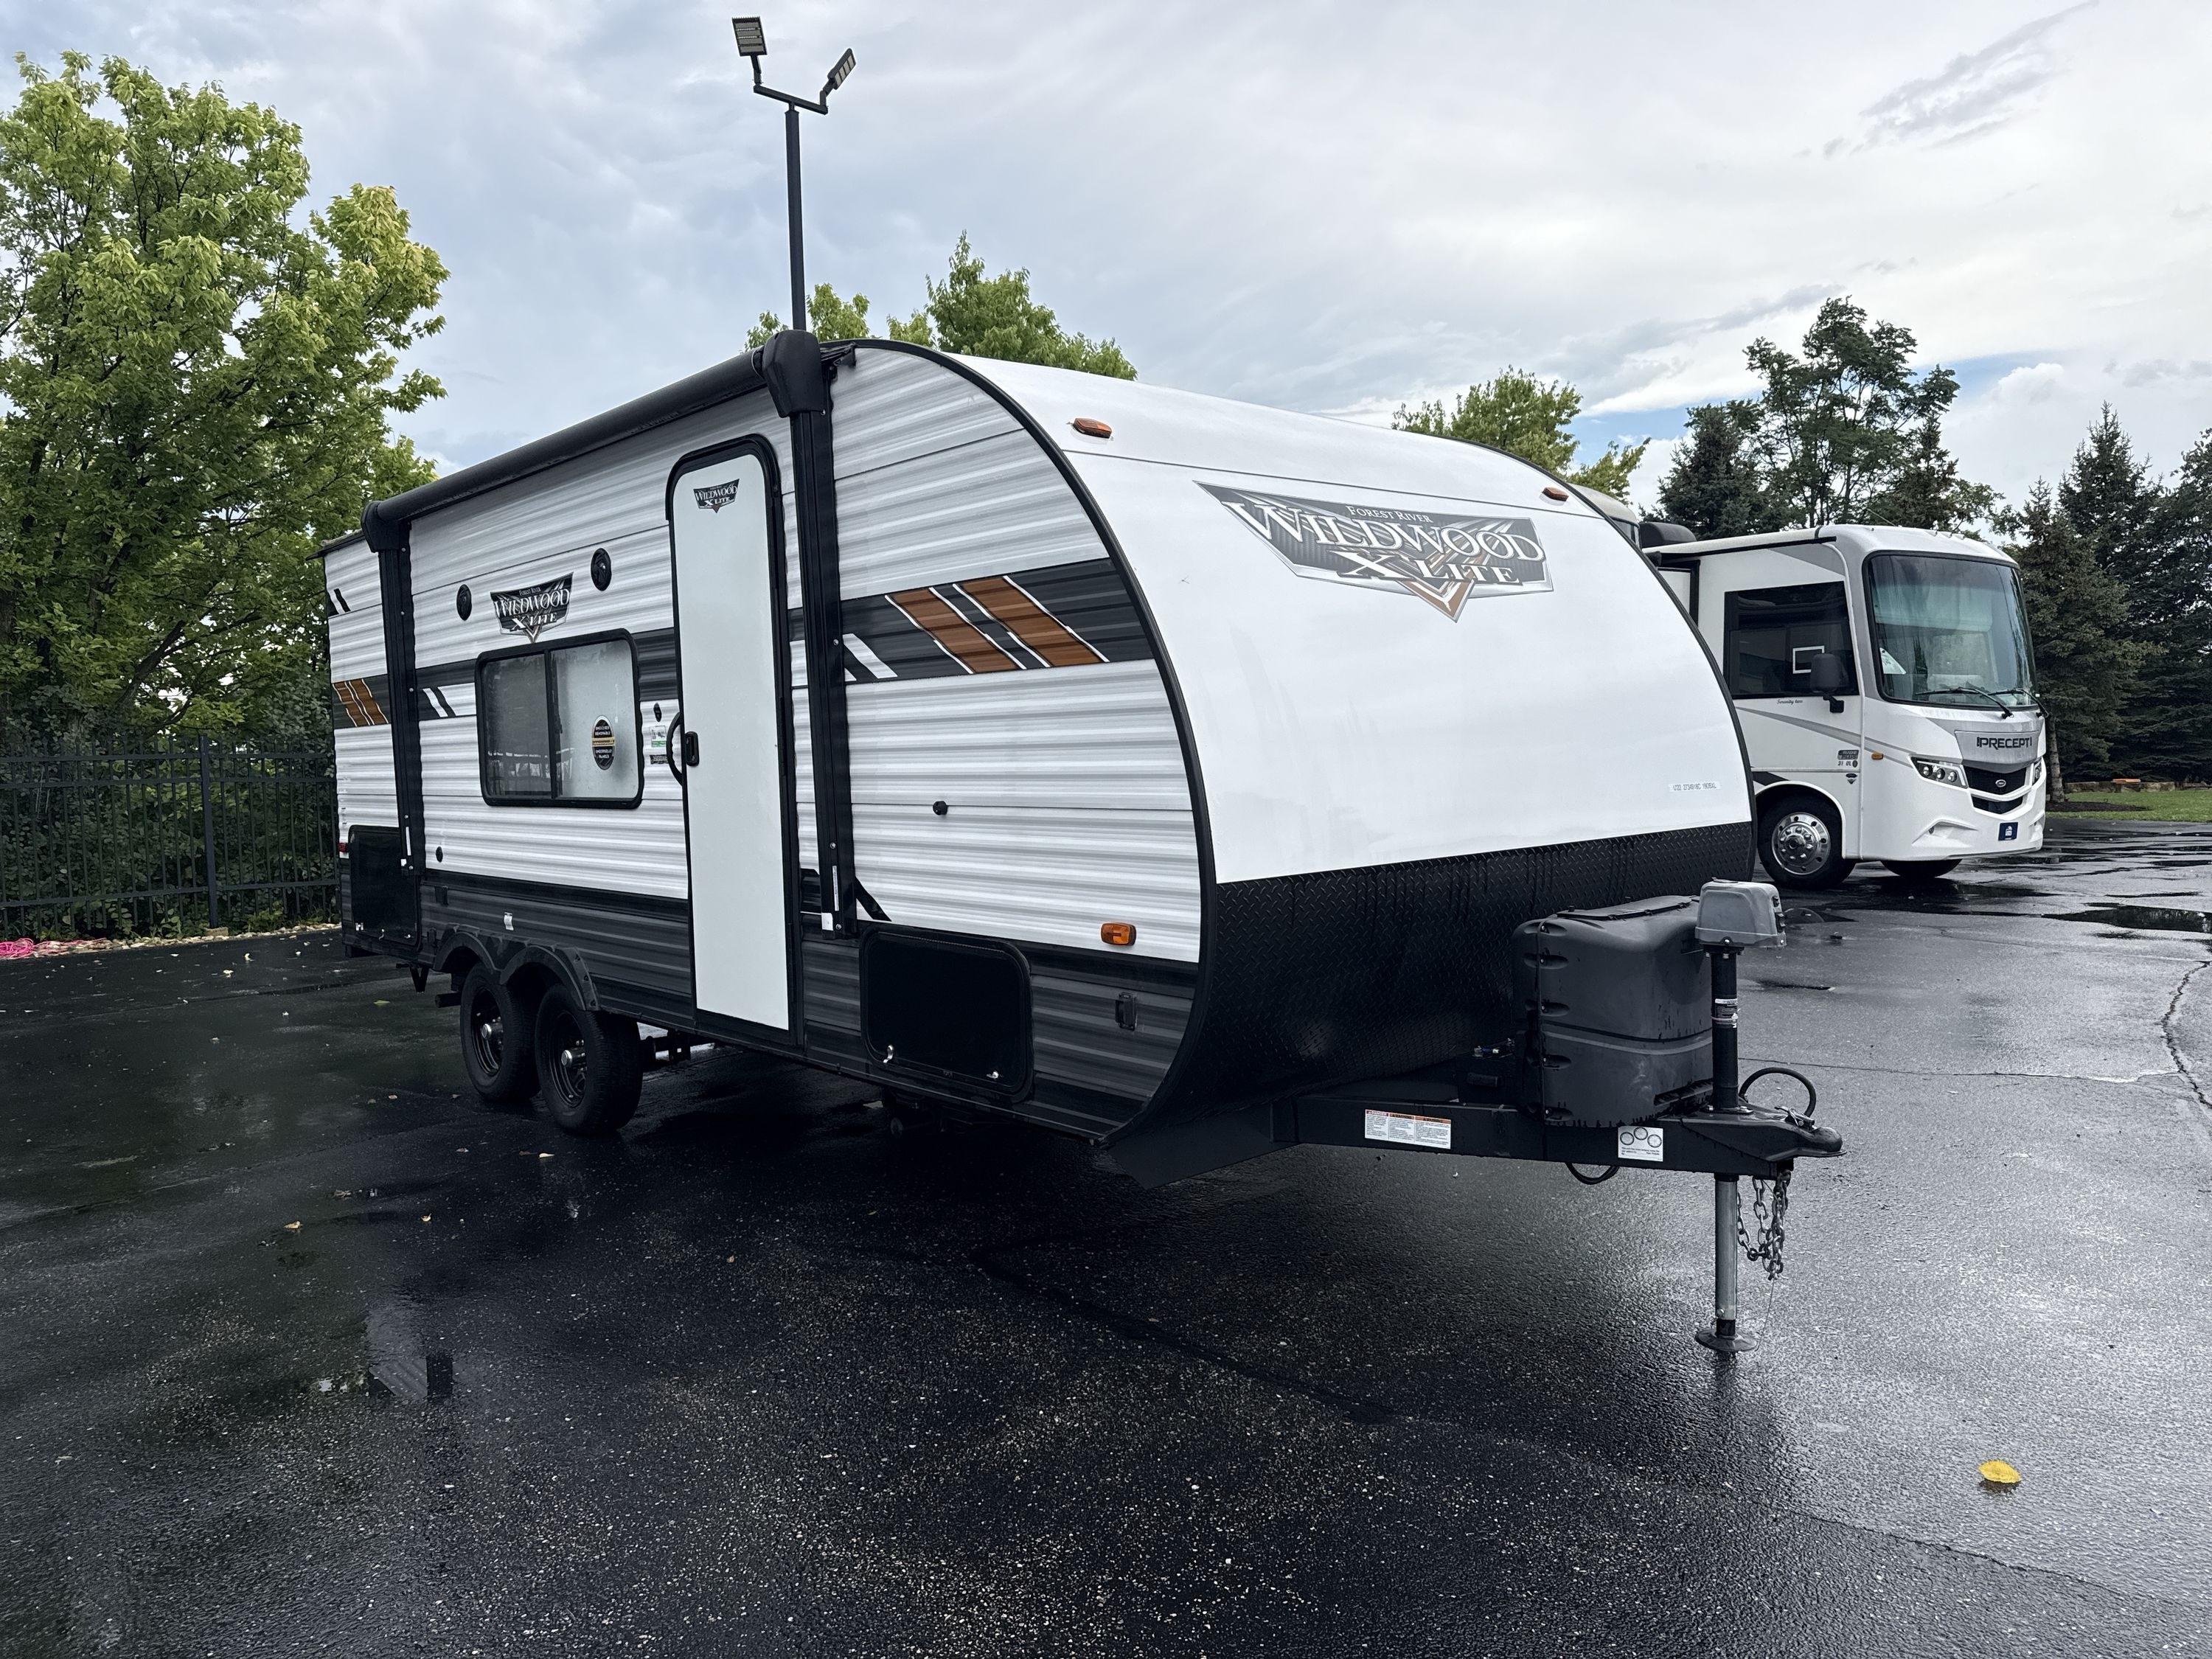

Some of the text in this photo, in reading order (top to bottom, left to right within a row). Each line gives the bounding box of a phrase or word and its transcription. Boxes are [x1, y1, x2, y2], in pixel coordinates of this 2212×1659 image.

[695, 485, 737, 501] WILDWOOD
[1346, 506, 1433, 523] FOREST RIVER
[1221, 501, 1545, 561] WILDWOOD
[1414, 560, 1523, 585] LITE
[494, 588, 570, 617] WILDWOOD
[529, 613, 557, 626] LITE
